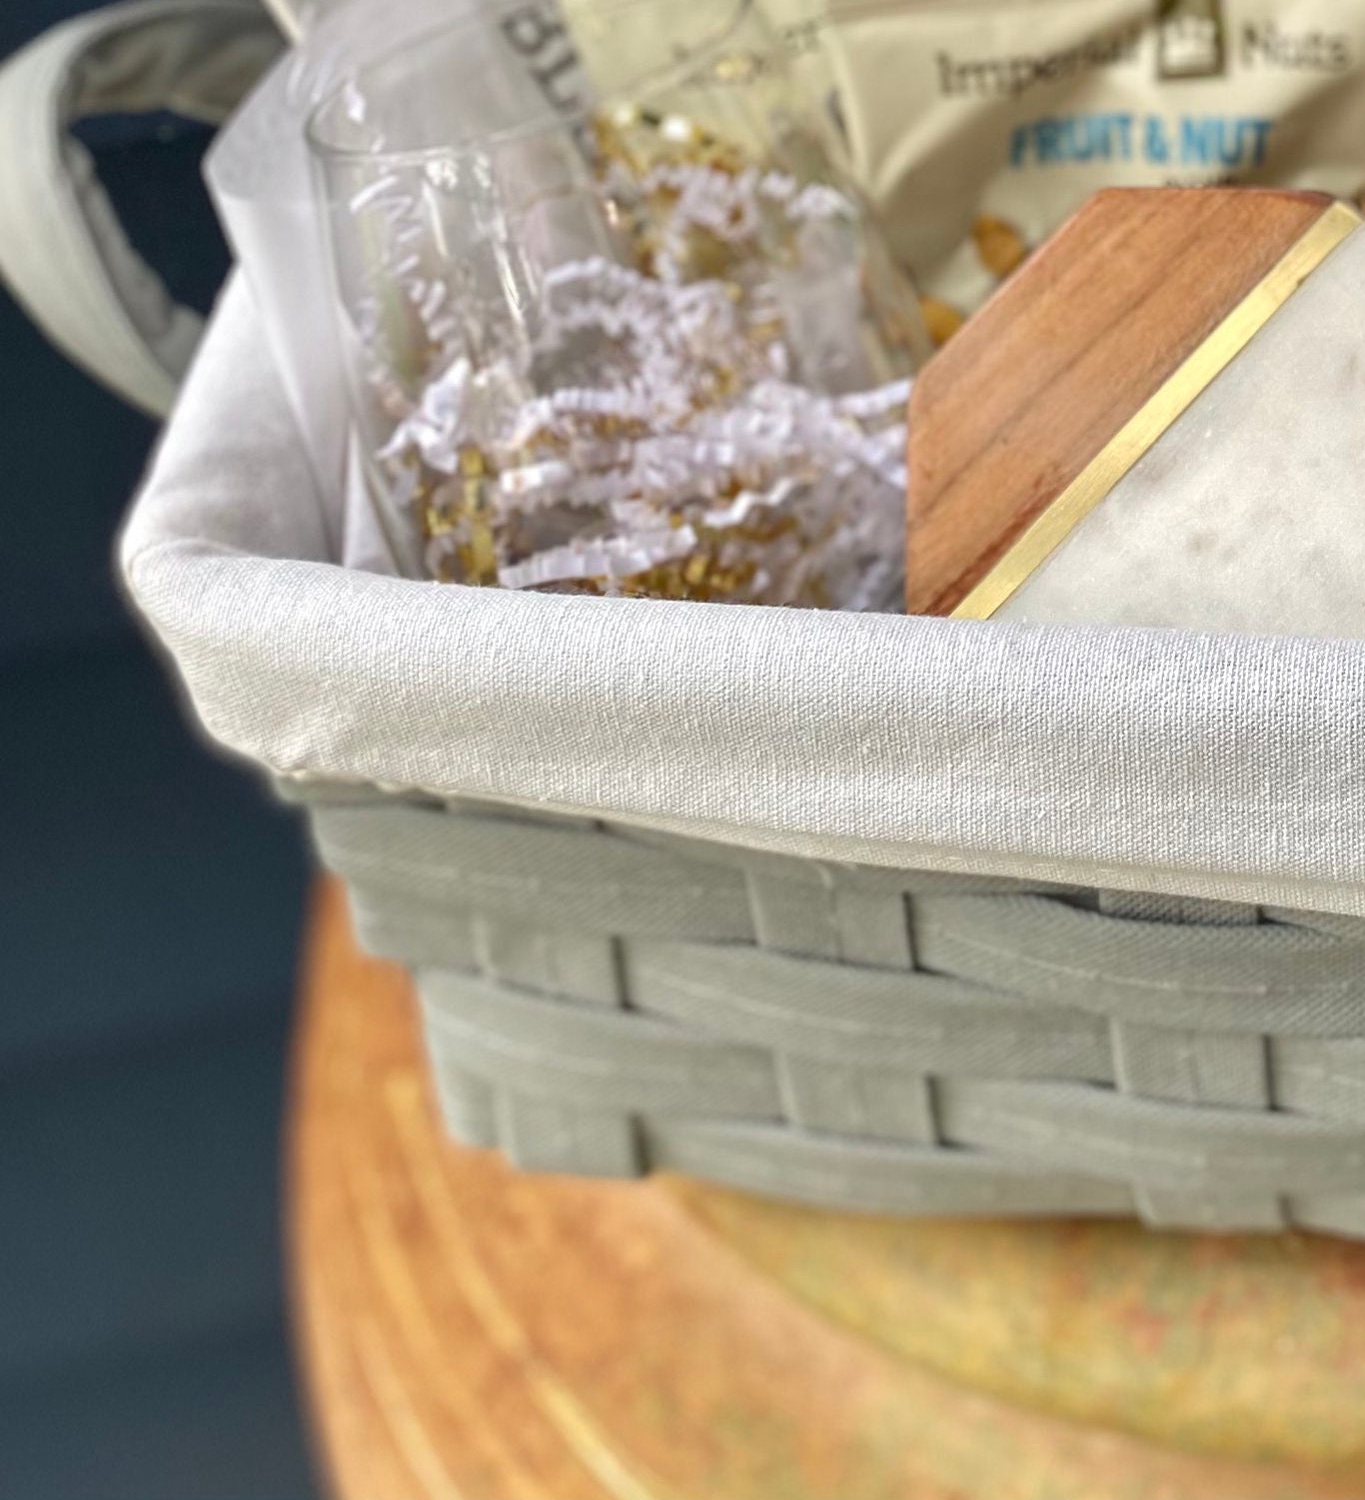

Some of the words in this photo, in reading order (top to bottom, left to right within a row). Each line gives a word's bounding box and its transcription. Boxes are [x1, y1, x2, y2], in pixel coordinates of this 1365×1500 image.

[1240, 19, 1351, 73] Nuts
[1008, 110, 1134, 171] FRUIT
[1144, 113, 1170, 164] &
[1179, 116, 1273, 168] NUT
